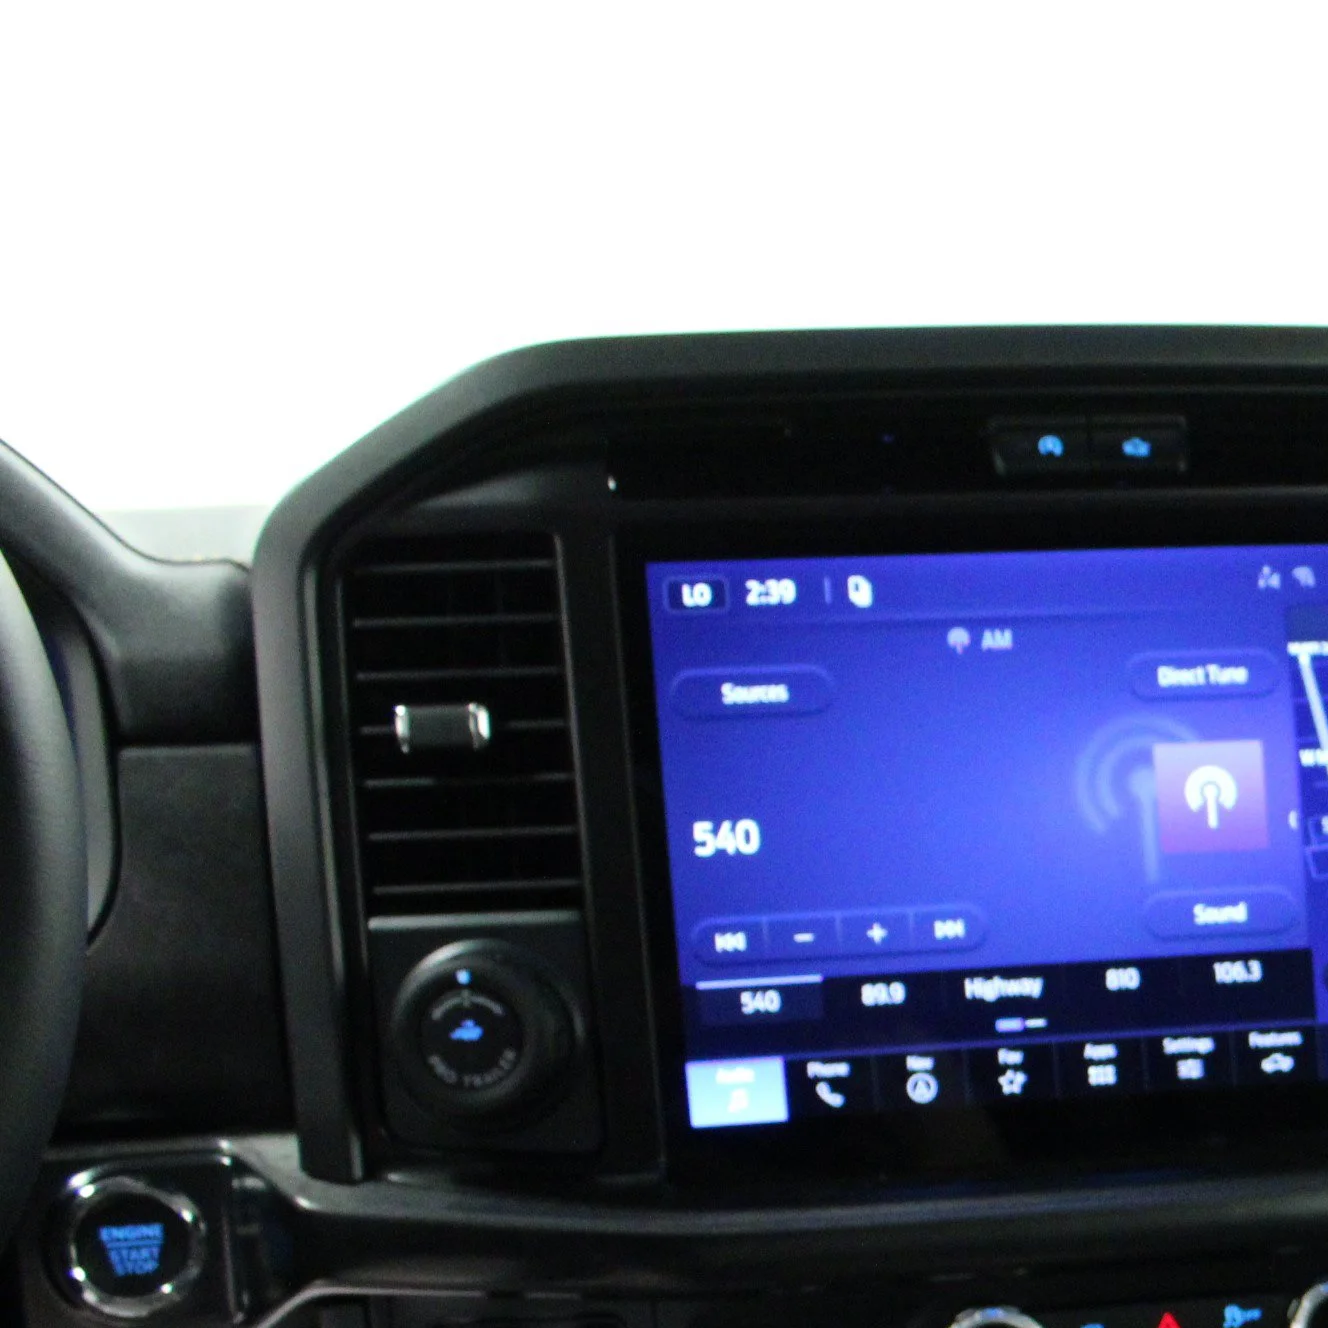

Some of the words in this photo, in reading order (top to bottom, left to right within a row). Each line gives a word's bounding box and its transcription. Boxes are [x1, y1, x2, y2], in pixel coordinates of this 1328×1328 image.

[682, 583, 711, 606] LO
[980, 629, 1014, 650] AM
[1157, 666, 1206, 687] Direct
[1207, 664, 1248, 684] Tune
[721, 683, 789, 704] Sources
[692, 819, 760, 857] 540
[1193, 902, 1247, 925] Sound
[964, 976, 1043, 1001] Highway
[740, 990, 781, 1014] 540
[807, 1061, 850, 1078] Phone
[99, 1224, 163, 1241] ENGINE
